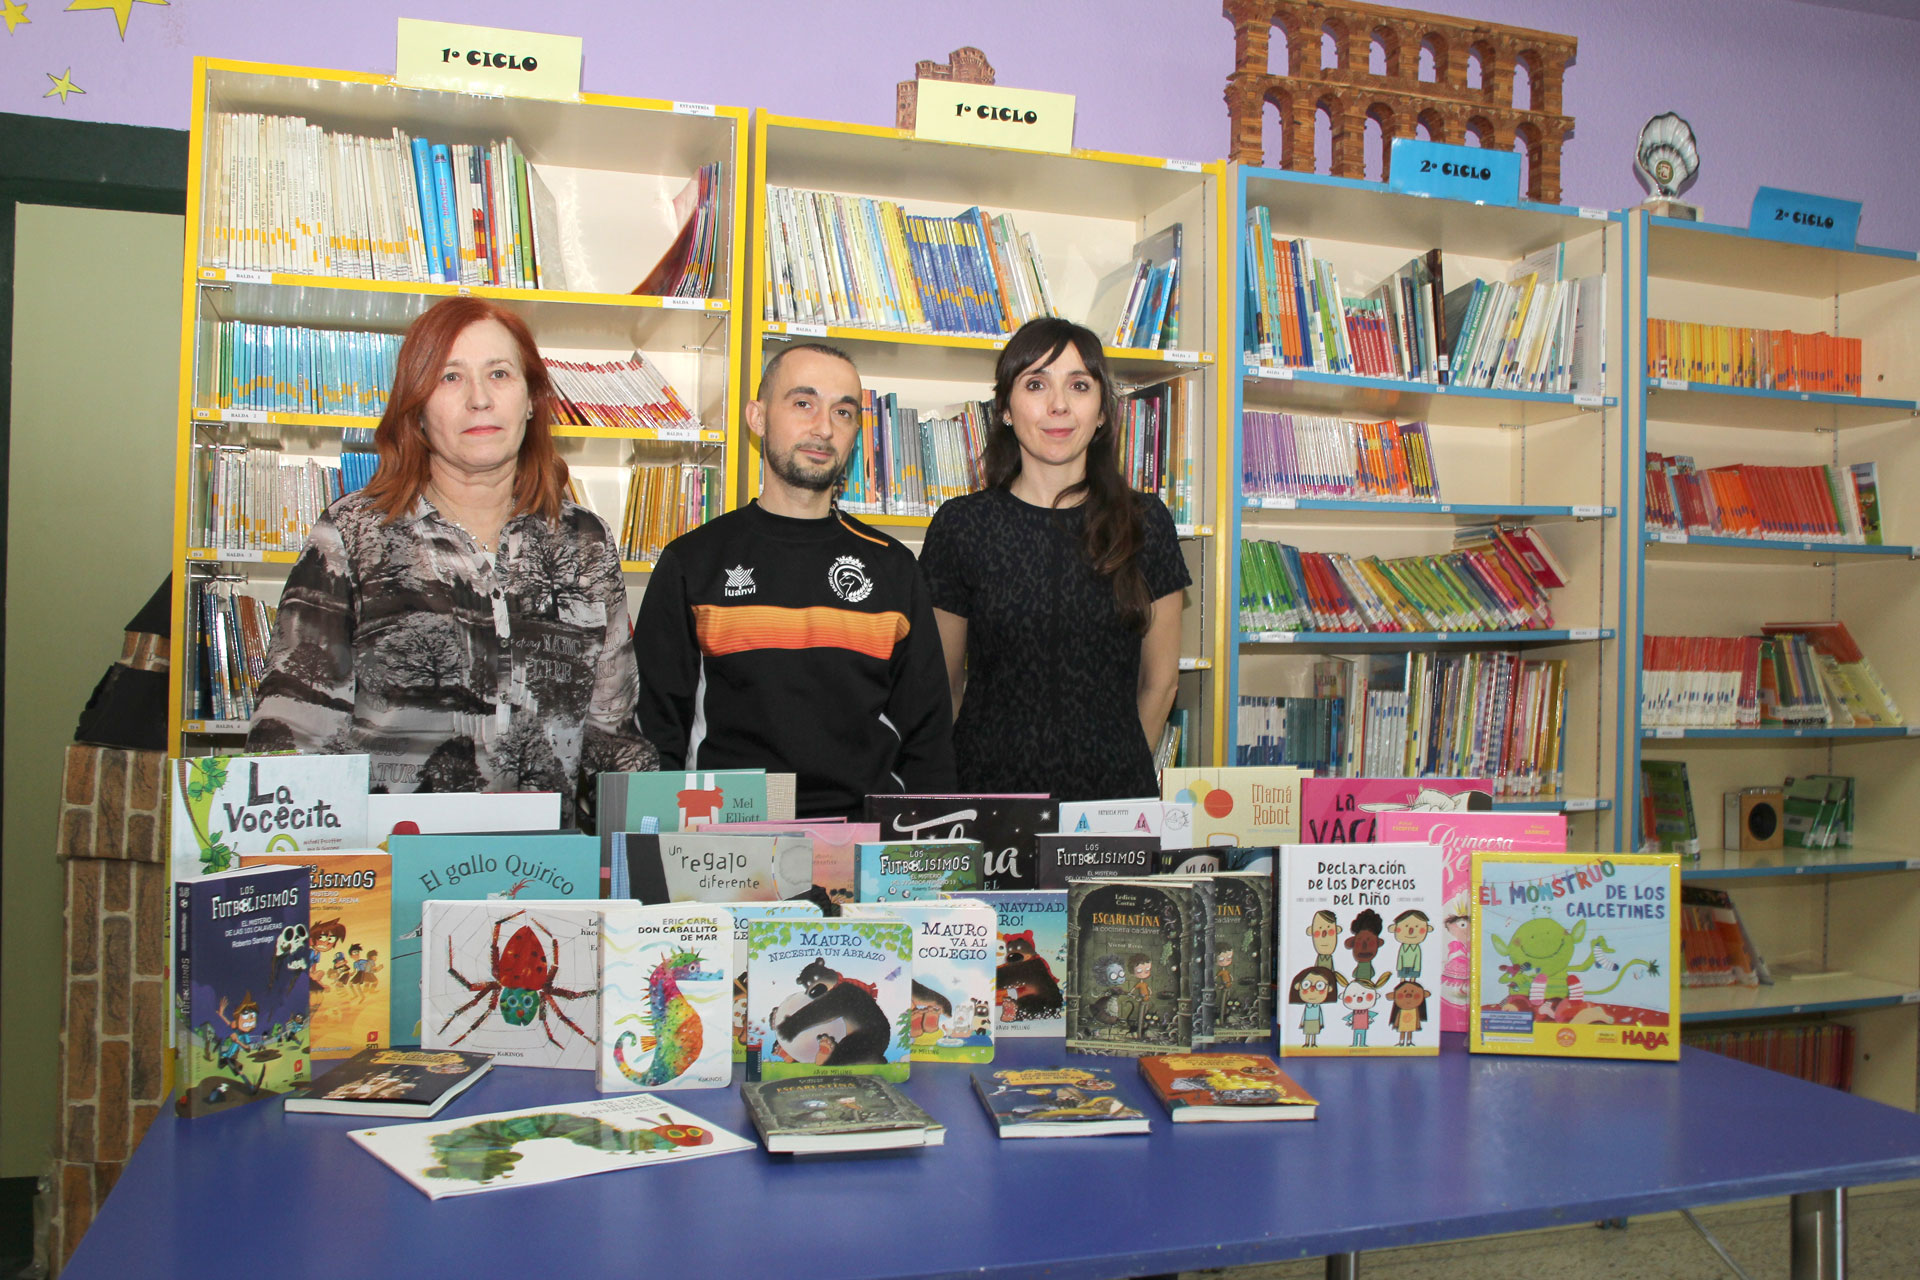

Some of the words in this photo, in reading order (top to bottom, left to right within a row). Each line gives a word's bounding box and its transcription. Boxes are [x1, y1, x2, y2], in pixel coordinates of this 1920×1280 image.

[466, 49, 538, 72] CICLO
[976, 104, 1038, 125] CICLO
[1441, 162, 1491, 181] CICLO
[1792, 210, 1834, 229] CICLO
[724, 585, 757, 597] luanvi
[247, 761, 294, 806] La
[1251, 783, 1292, 804] Mamá
[732, 798, 753, 809] Mel
[1336, 793, 1356, 812] La
[223, 799, 342, 834] Vocecita
[726, 812, 761, 823] Elliott
[1253, 805, 1291, 826] Robot
[1078, 819, 1087, 829] EL
[1137, 819, 1147, 829] LA
[1427, 823, 1515, 851] Princesa
[668, 845, 683, 856] Un
[909, 850, 924, 858] LOS
[1085, 843, 1100, 851] LOS
[681, 852, 747, 874] regalo
[1317, 859, 1407, 875] Declaración
[418, 869, 443, 893] El
[445, 853, 497, 886] gallo
[505, 854, 575, 896] Quirico
[699, 874, 760, 890] diferente
[240, 885, 255, 896] LOS
[1308, 878, 1324, 890] De
[1327, 877, 1348, 890] los
[1351, 877, 1417, 890] Derechos
[1478, 885, 1502, 906] EL
[1509, 860, 1616, 905] MONSTRUO
[1333, 892, 1355, 906] Del
[1359, 891, 1391, 906] Niño
[1605, 884, 1627, 900] DE
[1634, 885, 1666, 901] LOS
[1566, 902, 1666, 920] CALCETINES
[248, 917, 272, 926] MISTERIO
[253, 922, 283, 933] CALAVERAS
[686, 917, 718, 925] CARLE
[1092, 912, 1161, 928] ESCARLATINA
[638, 926, 660, 934] DON
[662, 925, 718, 934] CABALLITO
[695, 933, 718, 941] MAR
[921, 921, 988, 938] MAURO
[252, 935, 275, 945] Santiago
[800, 933, 863, 948] MAURO
[950, 937, 967, 947] VA
[971, 938, 988, 948] AL
[768, 947, 823, 962] NECESITA
[824, 947, 841, 957] UN
[842, 948, 886, 963] ABRAZO
[918, 946, 988, 960] COLEGIO
[1621, 1029, 1670, 1051] HABA
